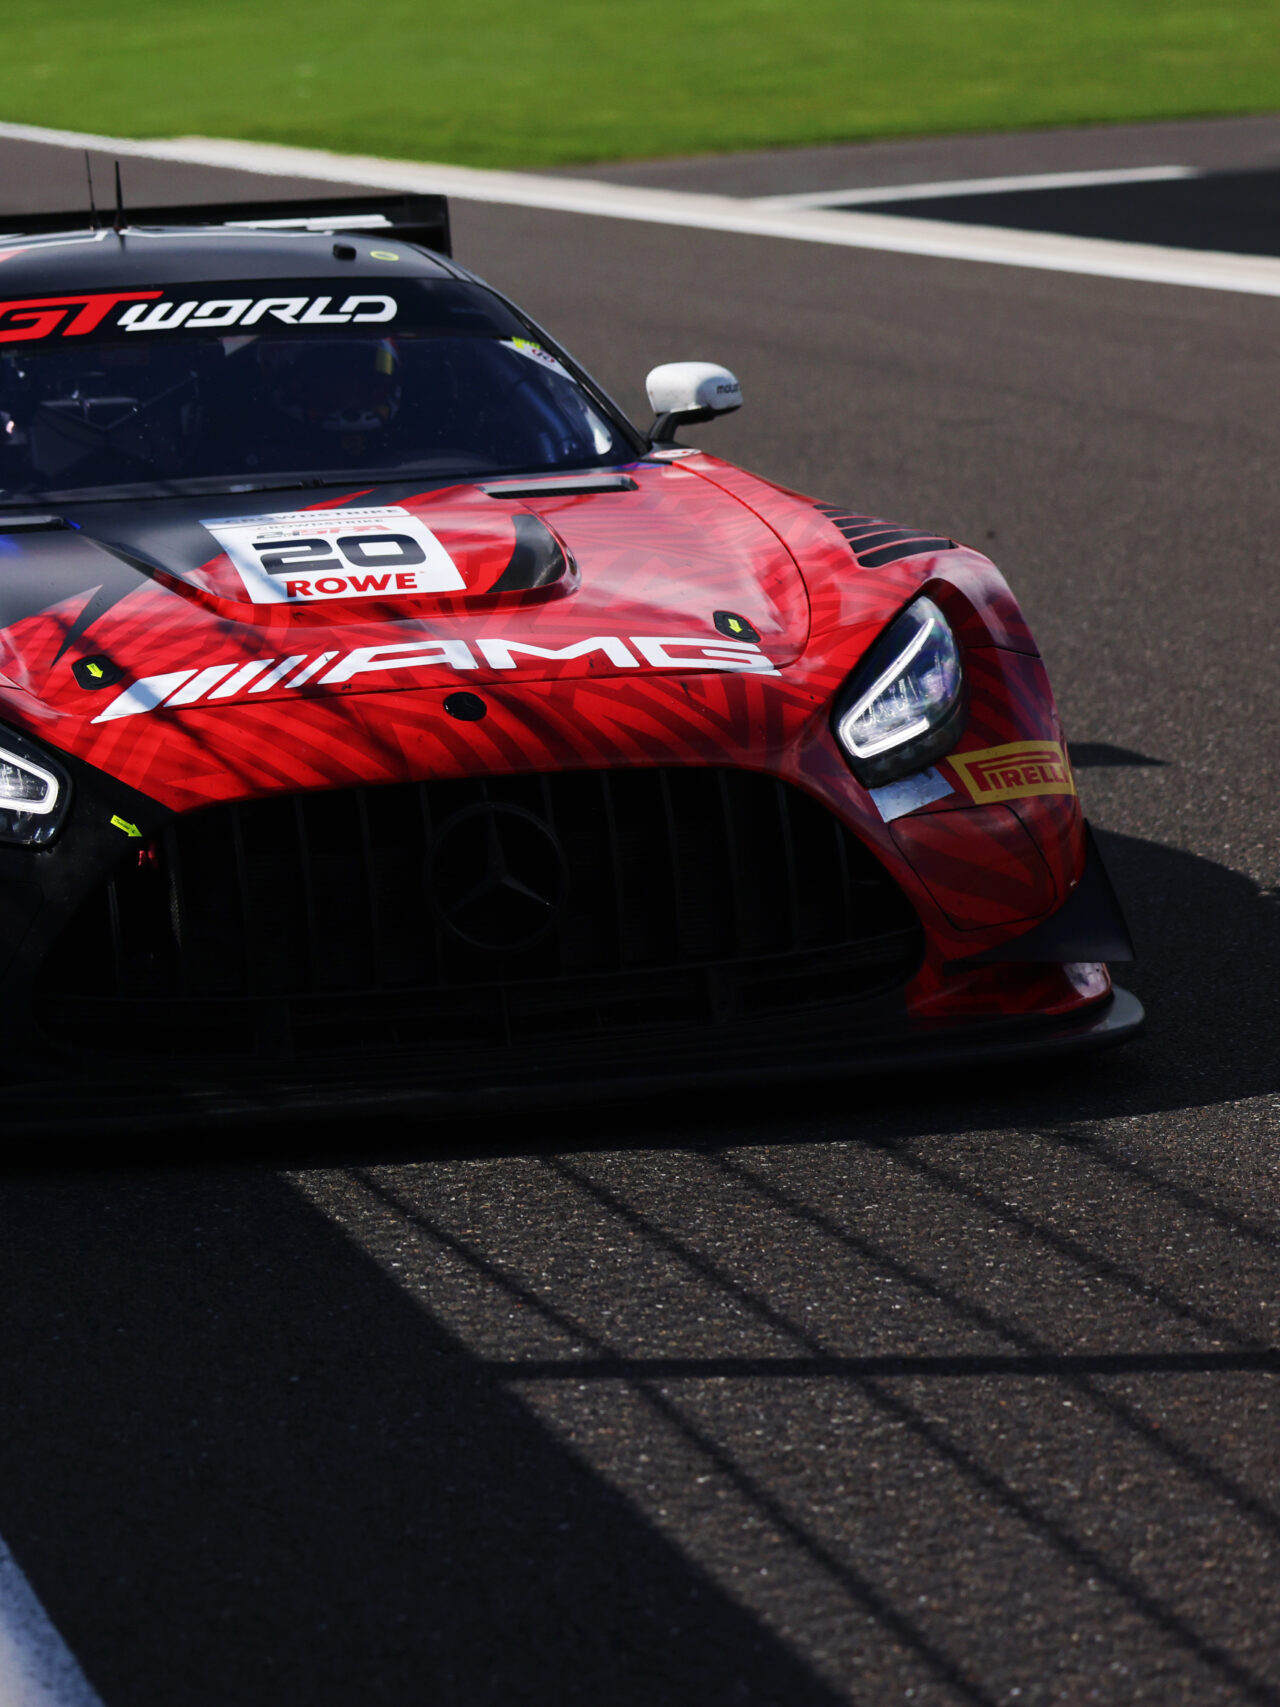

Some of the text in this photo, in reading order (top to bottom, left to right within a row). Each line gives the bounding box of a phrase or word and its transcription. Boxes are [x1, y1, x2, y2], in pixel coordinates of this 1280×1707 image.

[117, 295, 398, 332] WORLD
[224, 508, 398, 524] CROWDSTRIKE
[252, 534, 426, 575] 20
[284, 573, 417, 598] ROWE
[964, 751, 1070, 792] PIRELLI
